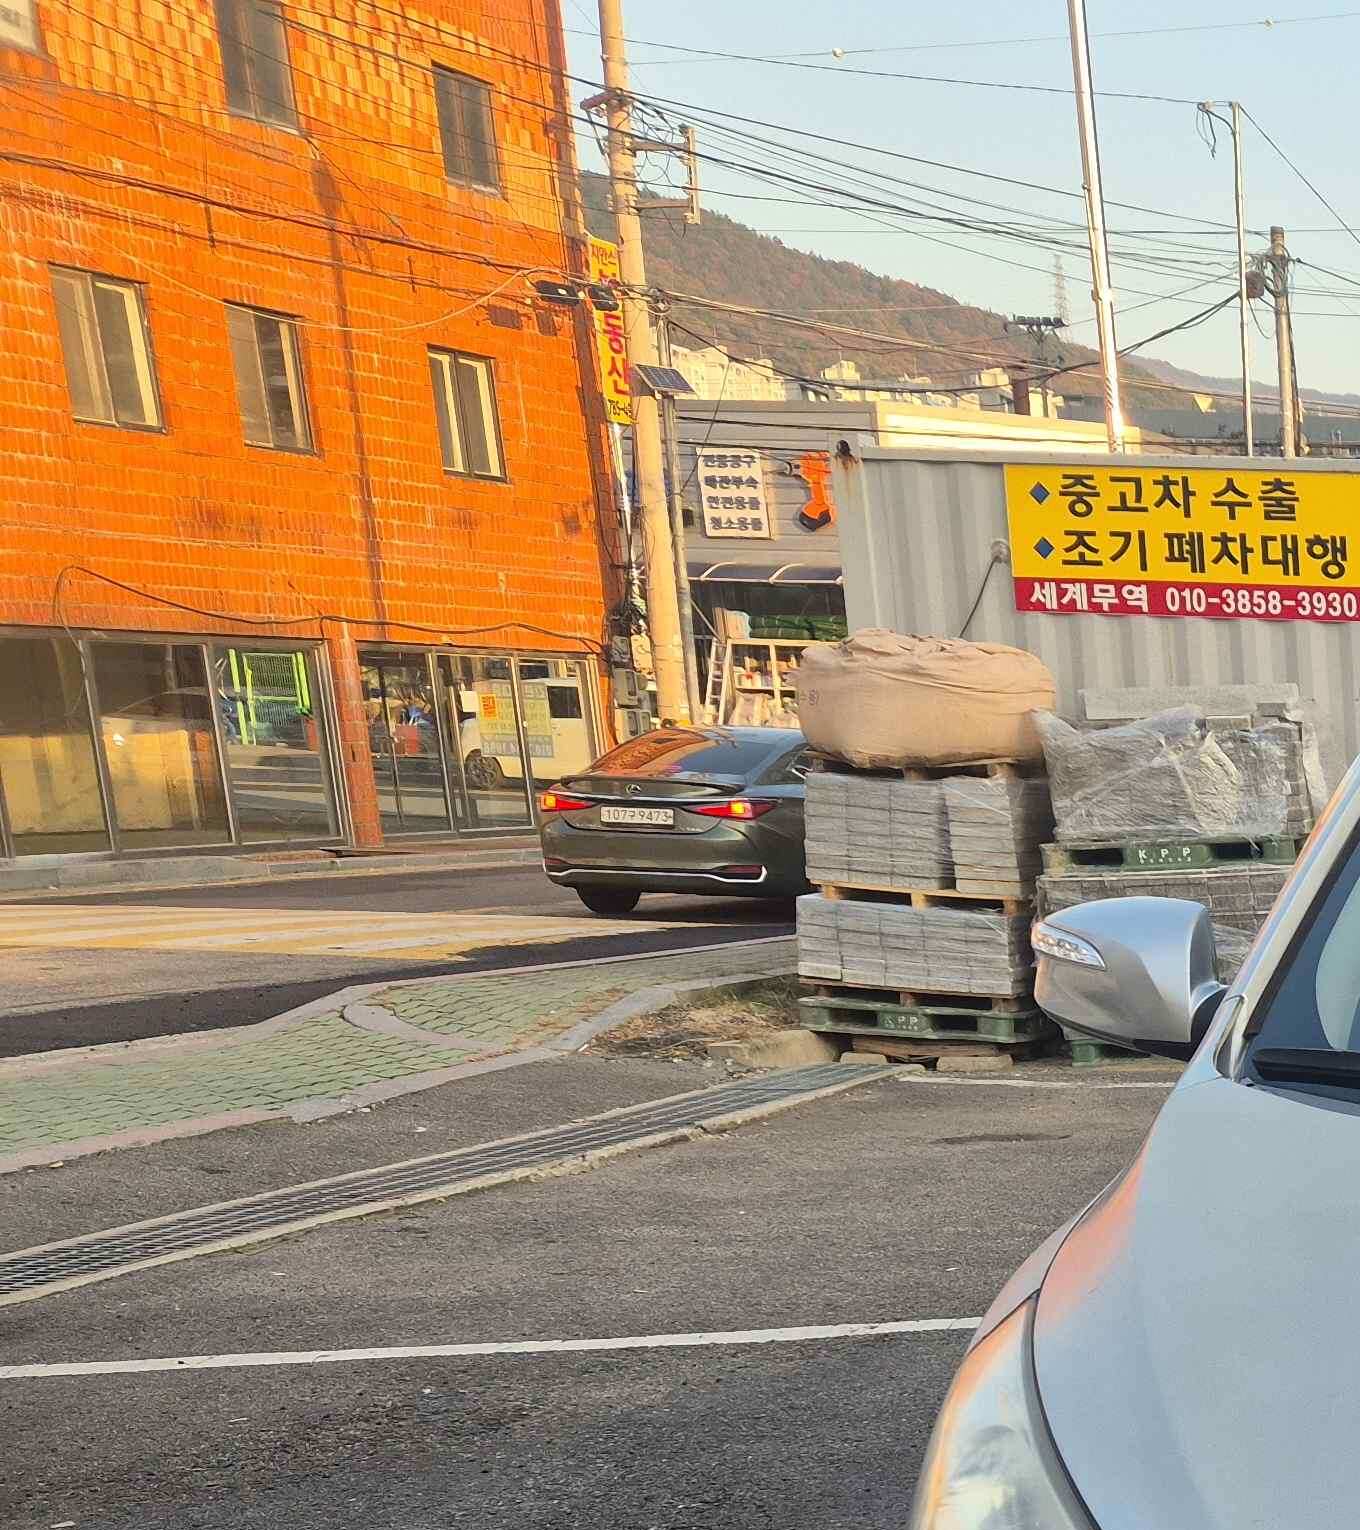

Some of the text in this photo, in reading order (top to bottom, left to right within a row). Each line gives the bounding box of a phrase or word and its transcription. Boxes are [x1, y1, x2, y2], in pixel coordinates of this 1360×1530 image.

[706, 495, 761, 510] 안전용품
[1059, 473, 1300, 521] 중고차 수출
[710, 516, 763, 531] 청소용품
[1061, 529, 1347, 579] 조기 폐차대행
[1030, 581, 1357, 617] 세계무역 010-3858-3930
